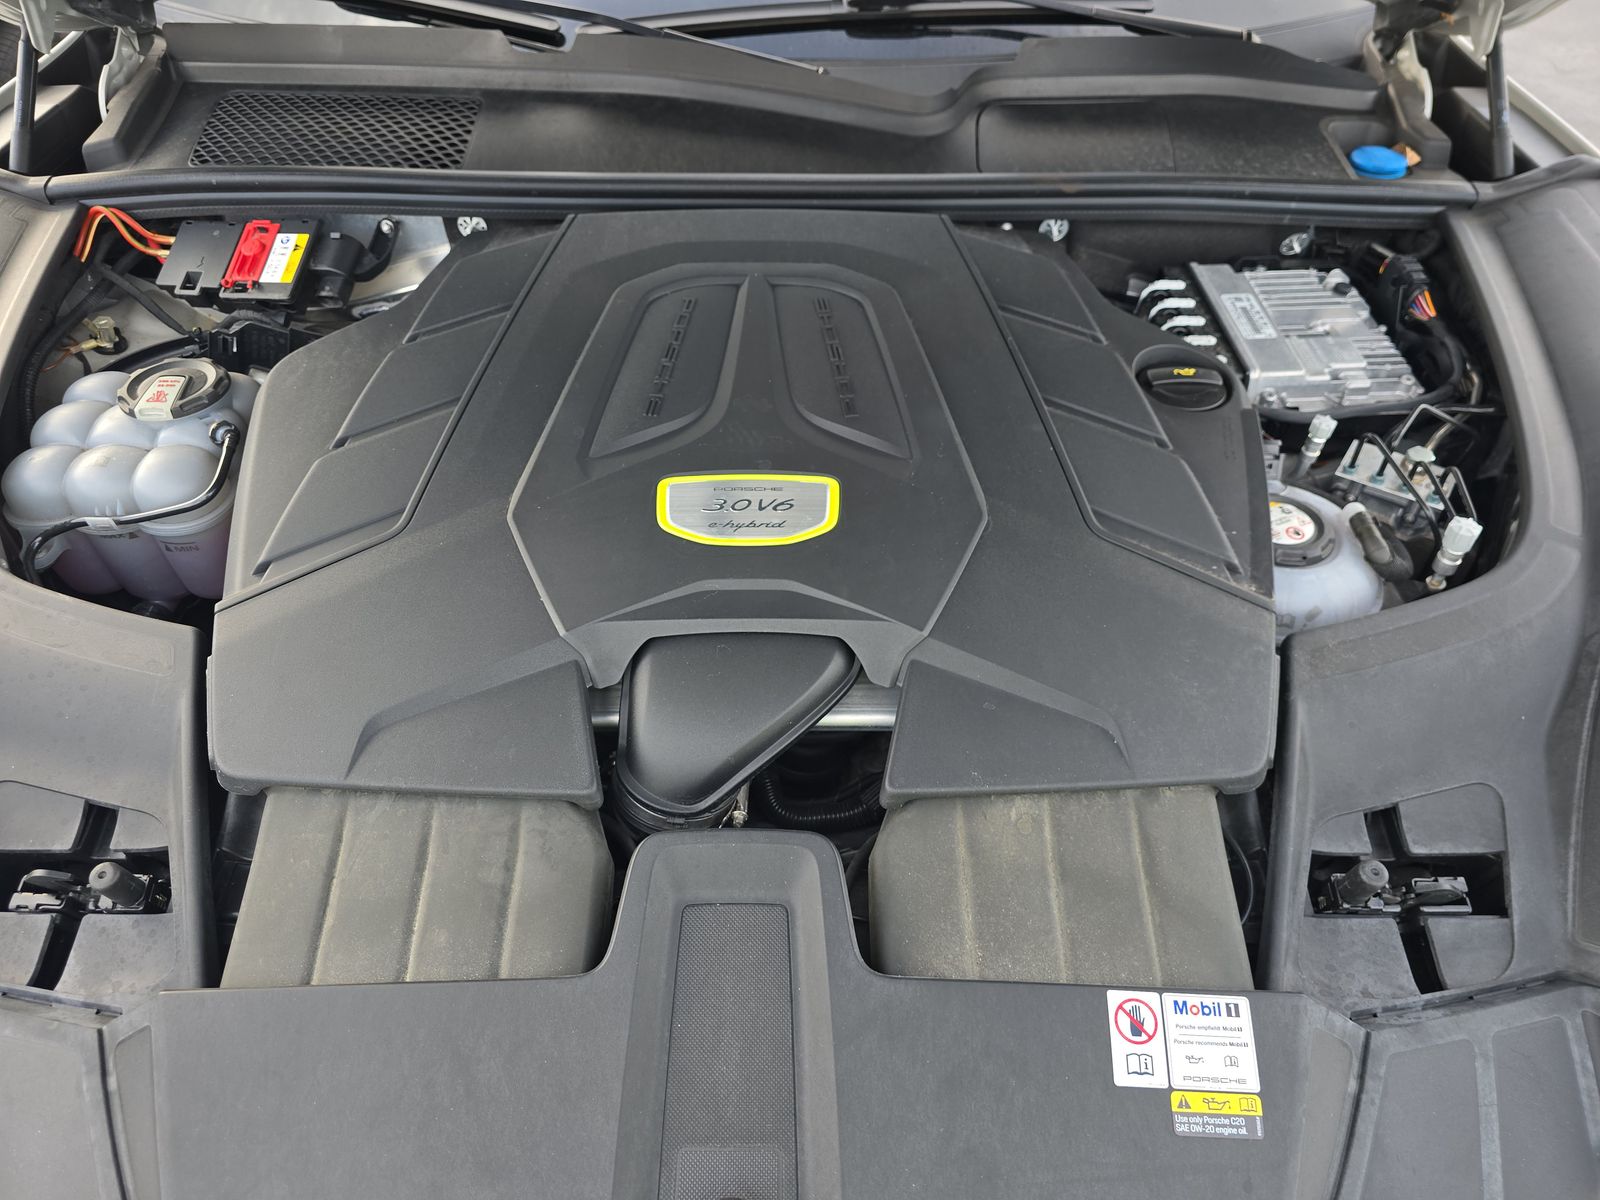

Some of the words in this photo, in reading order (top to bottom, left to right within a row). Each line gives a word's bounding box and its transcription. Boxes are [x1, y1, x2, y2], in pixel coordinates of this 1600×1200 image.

[642, 297, 697, 416] PORSCHE
[814, 297, 859, 417] PORSCHE
[702, 498, 752, 513] 3.0
[757, 498, 795, 512] V6
[708, 520, 787, 532] e-hybrid
[174, 544, 200, 552] MIN
[1173, 1000, 1221, 1017] Mobil
[1227, 1003, 1239, 1017] 1
[1183, 1075, 1247, 1084] PORSCHE
[1174, 1114, 1188, 1123] Use
[1190, 1115, 1203, 1124] only
[1203, 1116, 1230, 1125] Porsche
[1231, 1117, 1245, 1126] C20
[1175, 1124, 1190, 1132] SAE
[1190, 1124, 1214, 1133] 0W-20
[1215, 1126, 1237, 1135] engine
